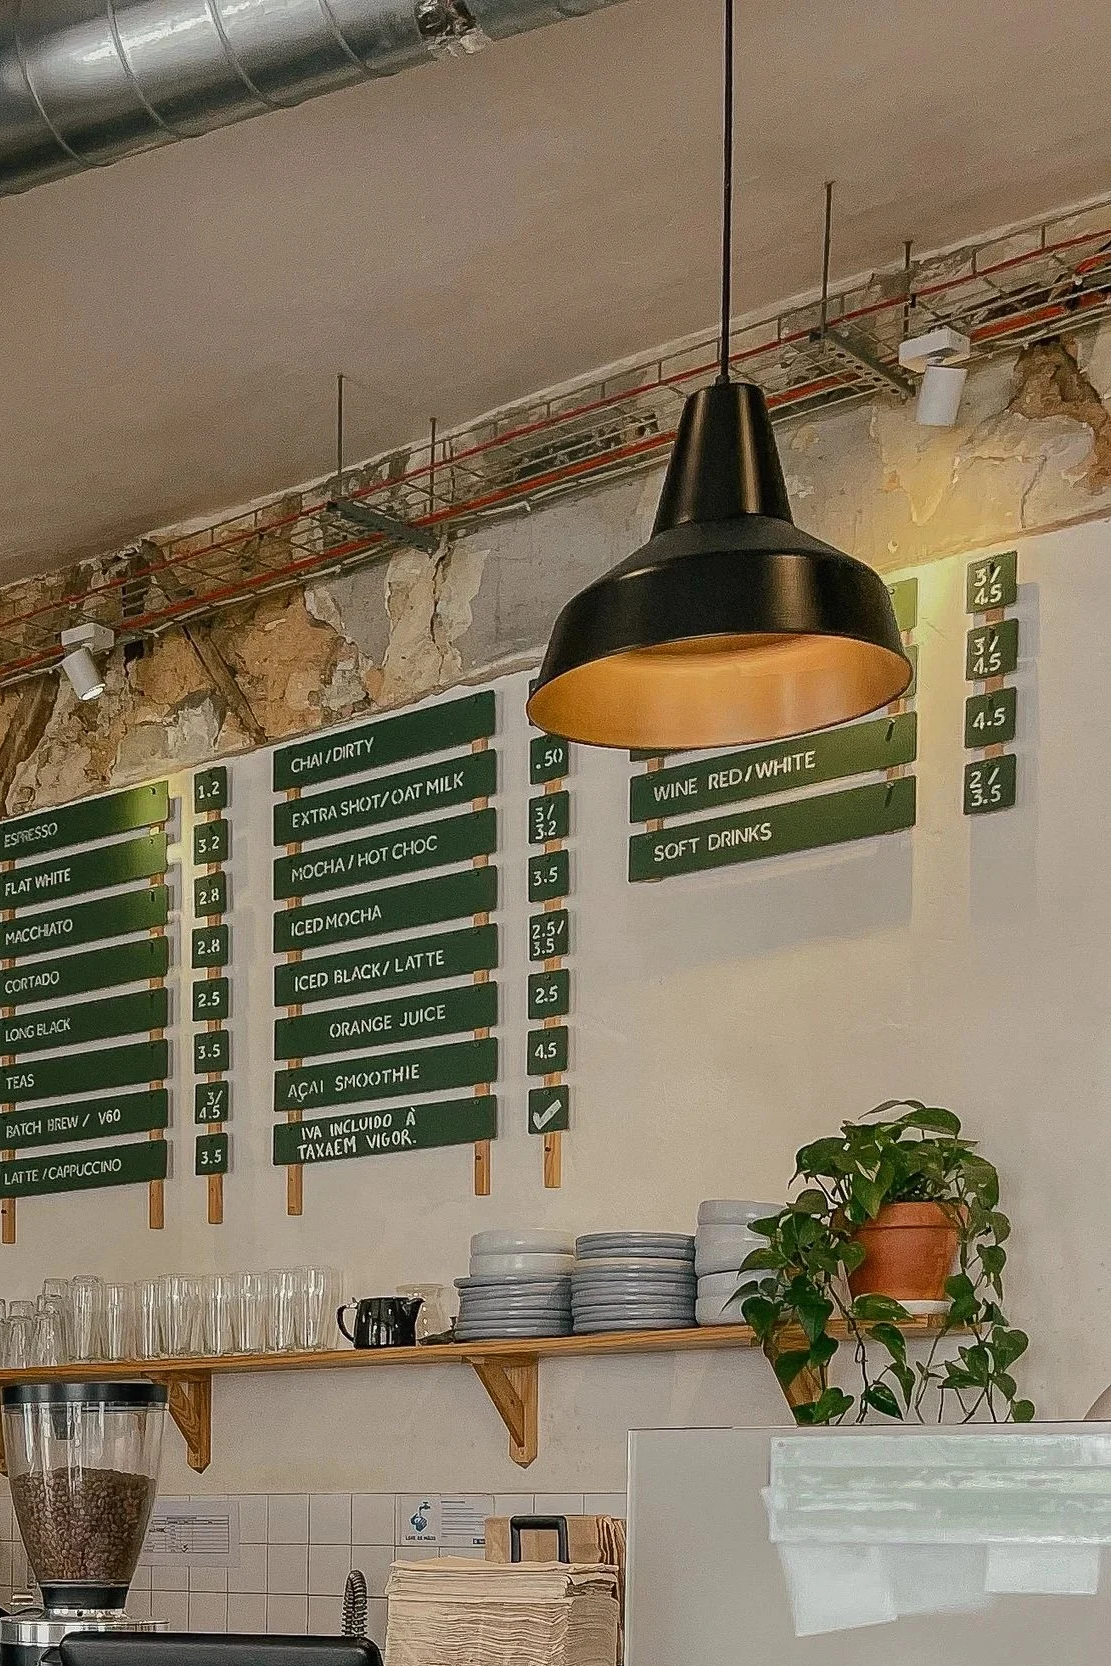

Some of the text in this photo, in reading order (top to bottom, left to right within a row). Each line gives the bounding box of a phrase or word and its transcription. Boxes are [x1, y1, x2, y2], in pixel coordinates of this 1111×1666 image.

[974, 564, 1001, 586] 3/
[974, 584, 1003, 605] 4.5
[973, 635, 1000, 657] 3/
[973, 653, 1002, 675] 4.5
[972, 707, 1006, 731] 4.5
[535, 747, 564, 770] .50
[653, 750, 816, 802] WINE RED/WHITE
[969, 766, 1000, 790] 2/
[197, 781, 220, 799] 1.2
[292, 806, 337, 829] EXTRA
[425, 771, 465, 795] MILK
[971, 784, 1002, 807] 3.5
[3, 822, 58, 848] ESPRESSO
[535, 820, 557, 840] 3.2
[197, 835, 219, 854] 3.2
[653, 822, 773, 863] SOFT DRINKS
[291, 858, 345, 883] MOCHA
[357, 846, 388, 869] HOT
[391, 835, 438, 861] CHOC
[5, 867, 71, 897] FLAT WHITE
[533, 866, 558, 885] 3.5
[199, 887, 220, 905] 2.8
[290, 904, 382, 937] ICED MOCHA
[532, 920, 565, 939] 2.5/
[5, 919, 73, 945] MACCHIATO
[197, 938, 221, 955] 2.8
[532, 938, 555, 957] 3.5
[5, 971, 60, 994] CORTADO
[294, 972, 328, 993] ICED
[395, 950, 445, 973] LATTE
[197, 991, 220, 1008] 2.5
[535, 985, 558, 1004] 2.5
[5, 1018, 71, 1042] LONG BLACK
[329, 1004, 446, 1039] ORANGE JUICE
[198, 1043, 221, 1060] 3.5
[534, 1042, 557, 1060] 4.5
[6, 1074, 35, 1090] TEAS
[335, 1064, 420, 1092] SMOOTHIE
[206, 1090, 223, 1105] 3/
[199, 1104, 221, 1120] 4.5
[6, 1121, 41, 1139] BATCH
[47, 1116, 79, 1132] BREW
[98, 1109, 121, 1125] V60
[301, 1125, 322, 1141] IVA
[329, 1113, 392, 1135] INCLUIDO
[366, 1129, 417, 1149] VIGOR.
[200, 1149, 222, 1165] 3.5
[4, 1168, 39, 1186] LATTE
